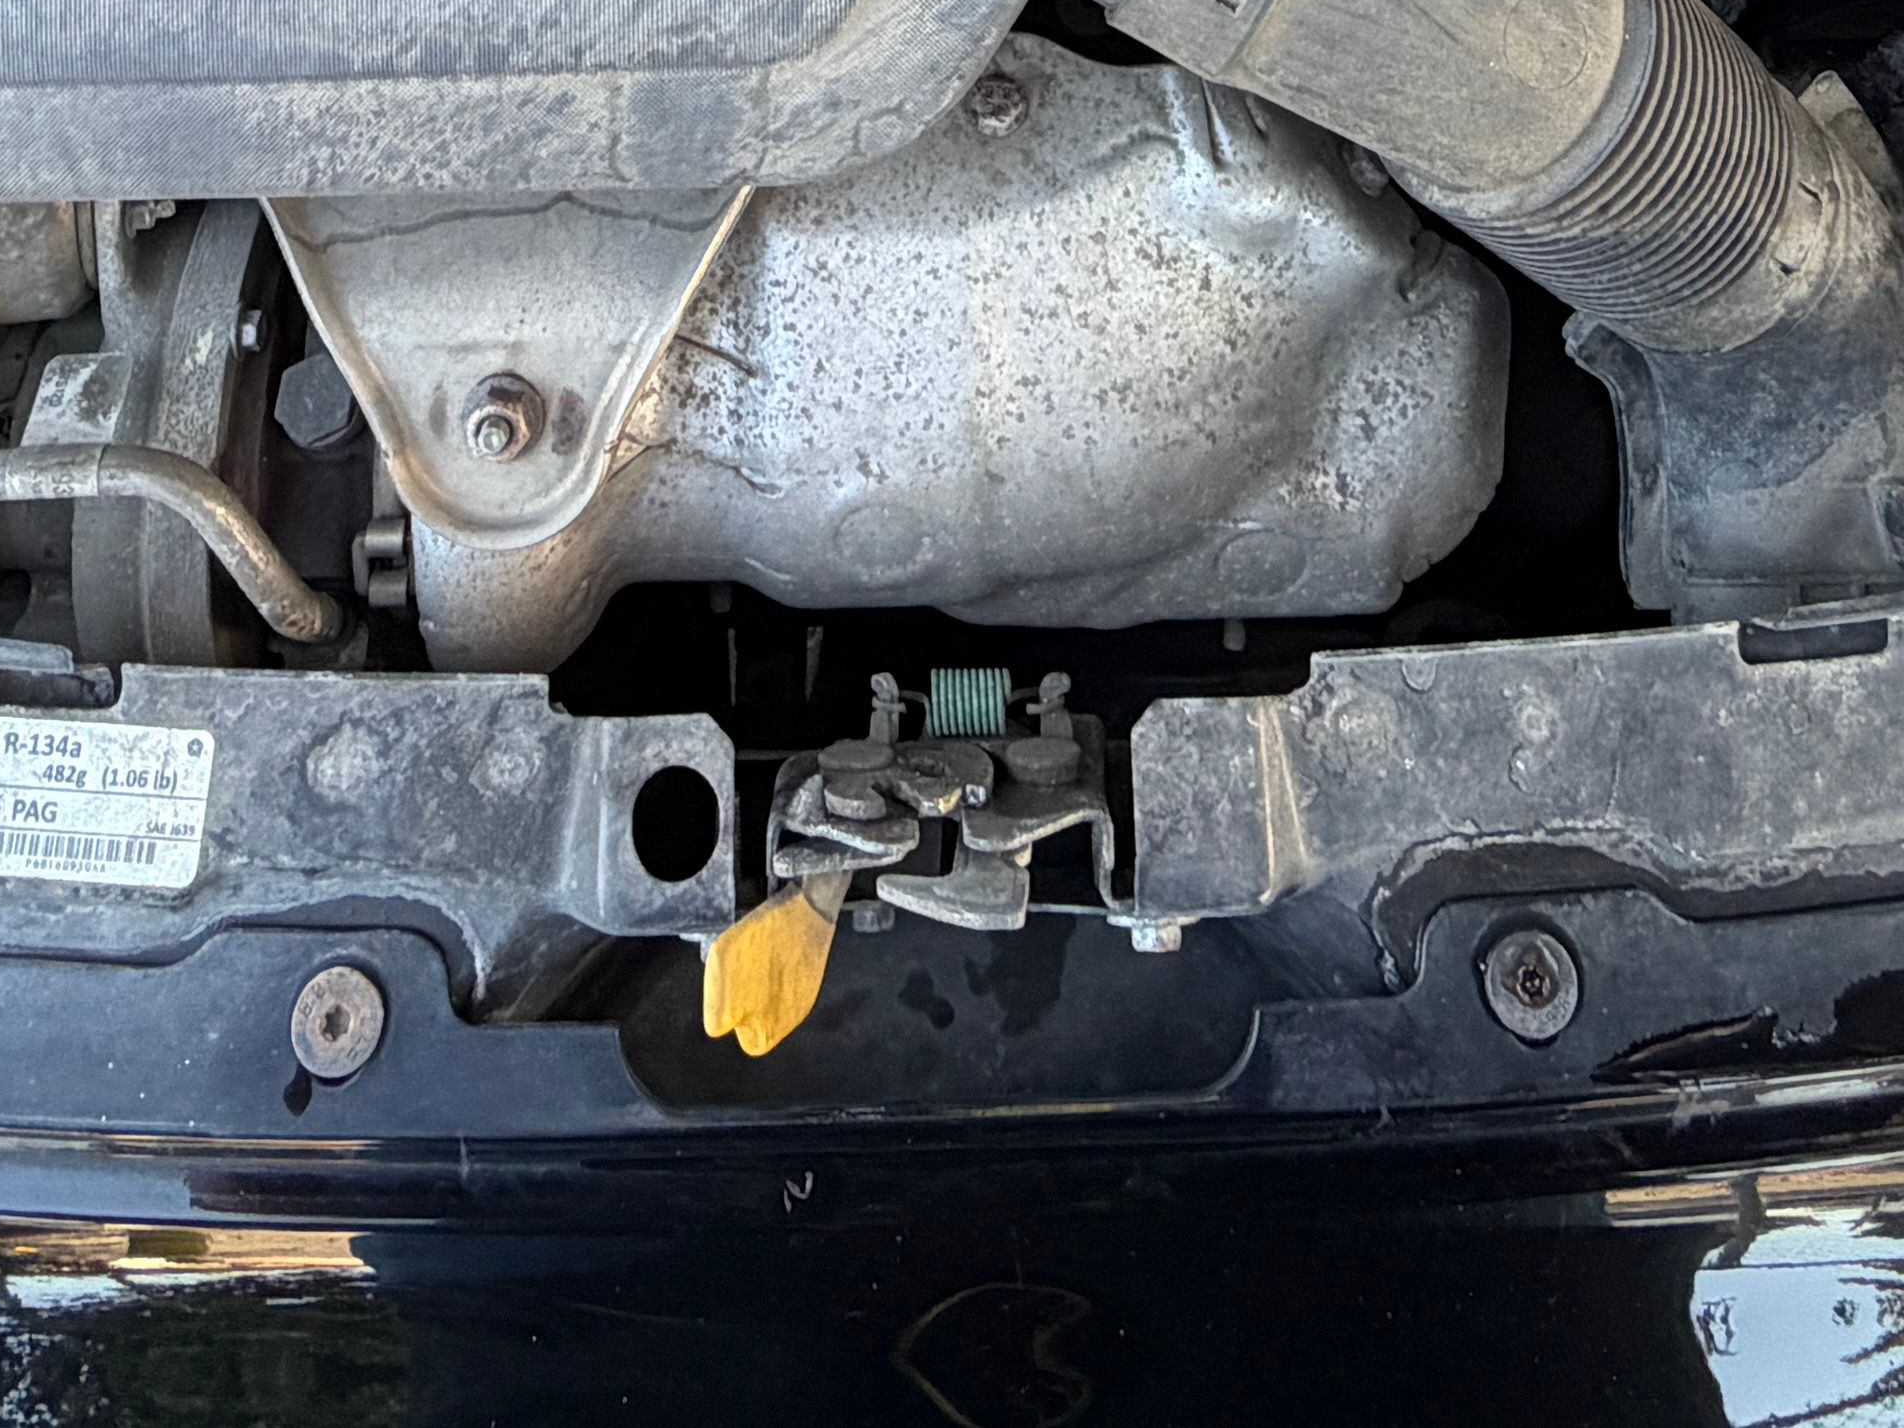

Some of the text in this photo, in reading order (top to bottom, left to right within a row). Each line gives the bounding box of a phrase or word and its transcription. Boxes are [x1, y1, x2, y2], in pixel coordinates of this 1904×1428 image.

[4, 732, 82, 758] R-134a
[42, 765, 179, 794] 482g (1.06 lb)
[12, 799, 59, 823] PAG
